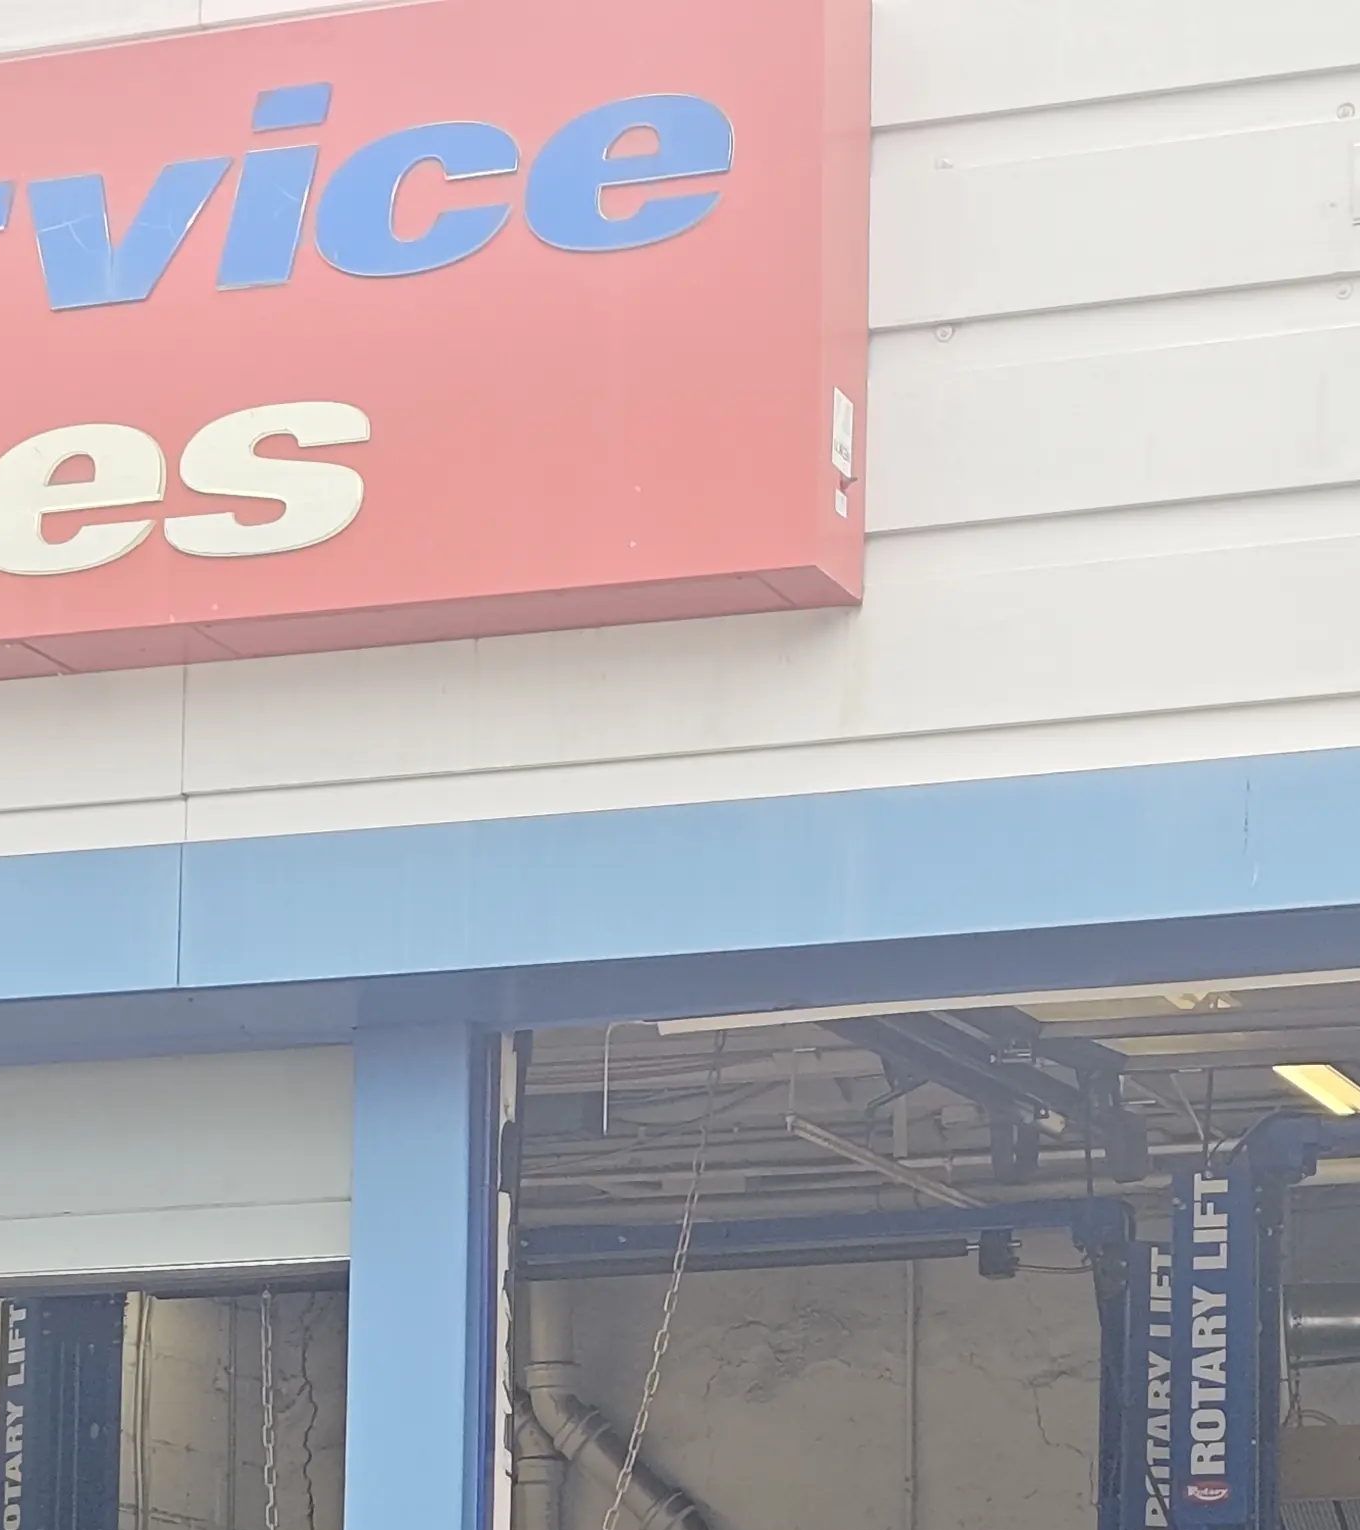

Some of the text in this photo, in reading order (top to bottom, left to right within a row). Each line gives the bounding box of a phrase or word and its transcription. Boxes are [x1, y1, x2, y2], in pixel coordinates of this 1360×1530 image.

[6, 1303, 27, 1387] LIFT
[1190, 1172, 1229, 1476] ROTARY LIFT
